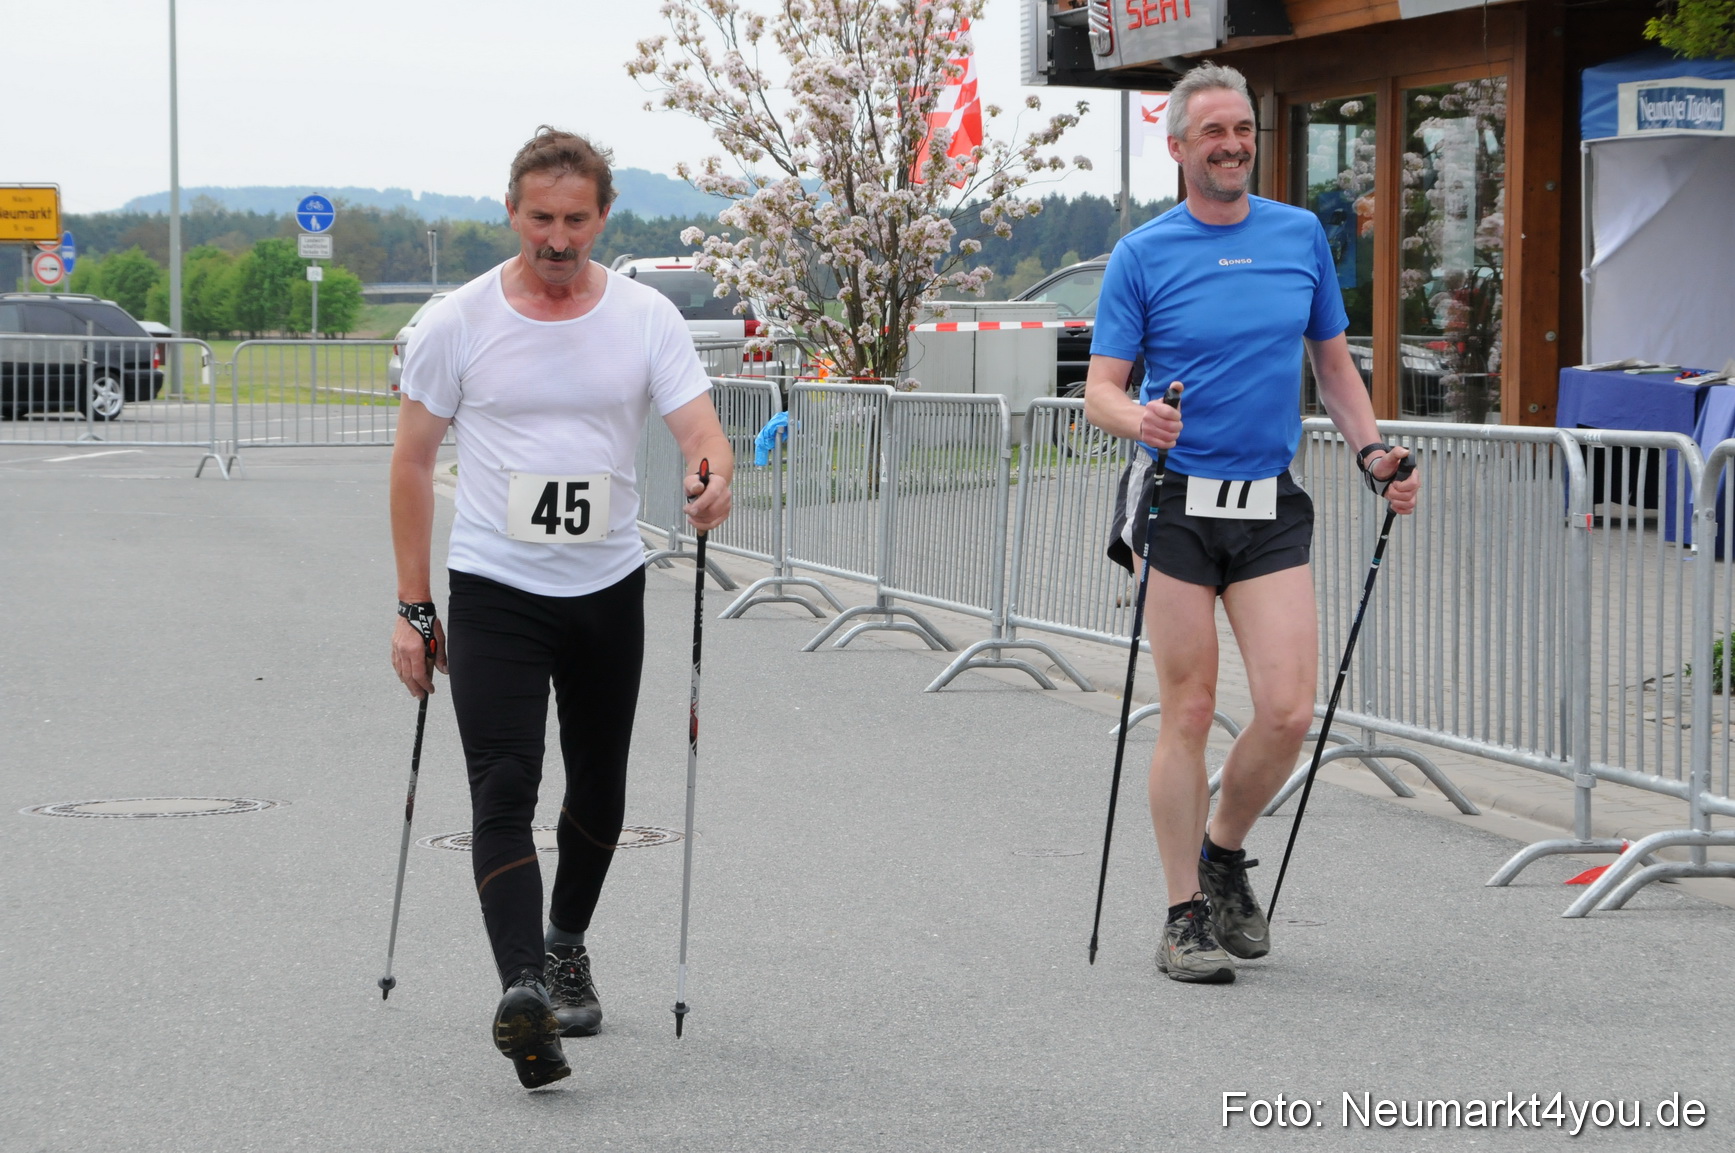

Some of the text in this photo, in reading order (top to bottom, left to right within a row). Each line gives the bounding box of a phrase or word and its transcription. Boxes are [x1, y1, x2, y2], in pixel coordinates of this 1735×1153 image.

[0, 206, 52, 219] eumarkt
[531, 481, 591, 536] 45
[417, 606, 431, 634] LEKI
